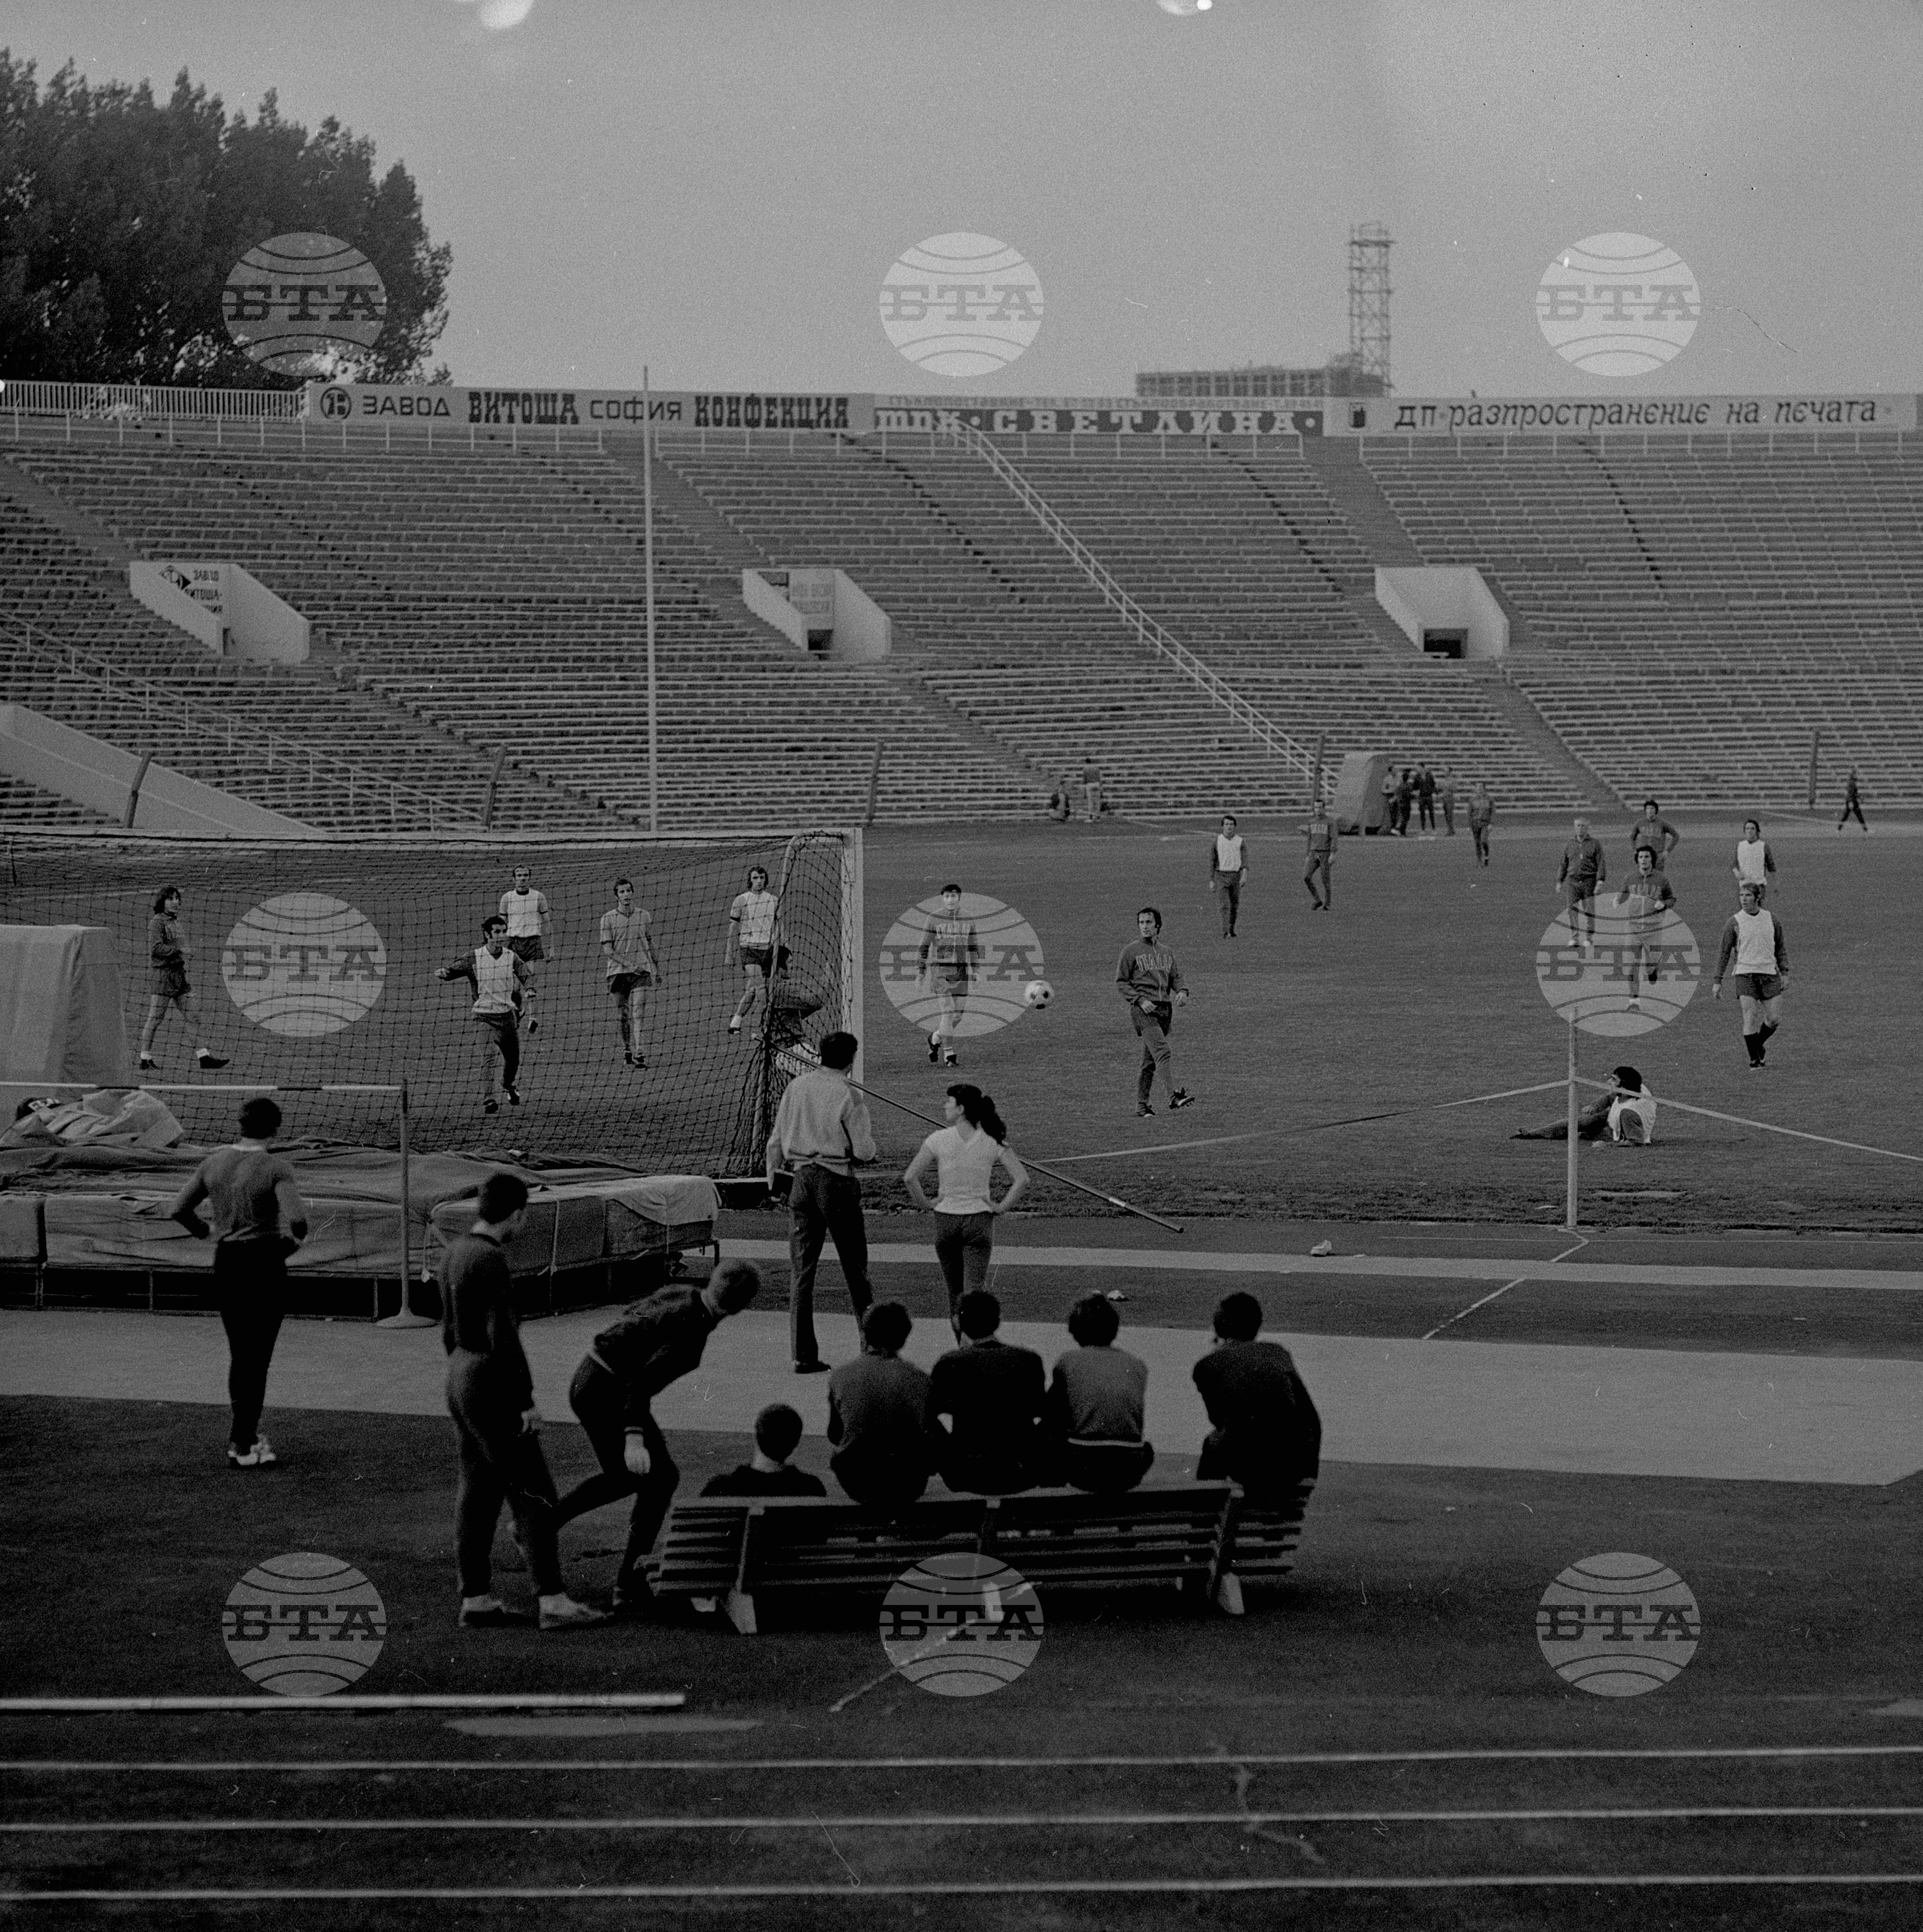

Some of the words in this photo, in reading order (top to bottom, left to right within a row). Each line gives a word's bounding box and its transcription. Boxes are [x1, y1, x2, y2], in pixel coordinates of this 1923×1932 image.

[363, 395, 451, 416] ЗАВОД
[468, 392, 580, 425] ВИТОША
[590, 396, 682, 424] СОФИЯ
[694, 393, 849, 429] КОНФЕКЦИЯ
[1449, 402, 1711, 434] разпространение
[1726, 402, 1760, 424] на
[1775, 400, 1877, 424] печата
